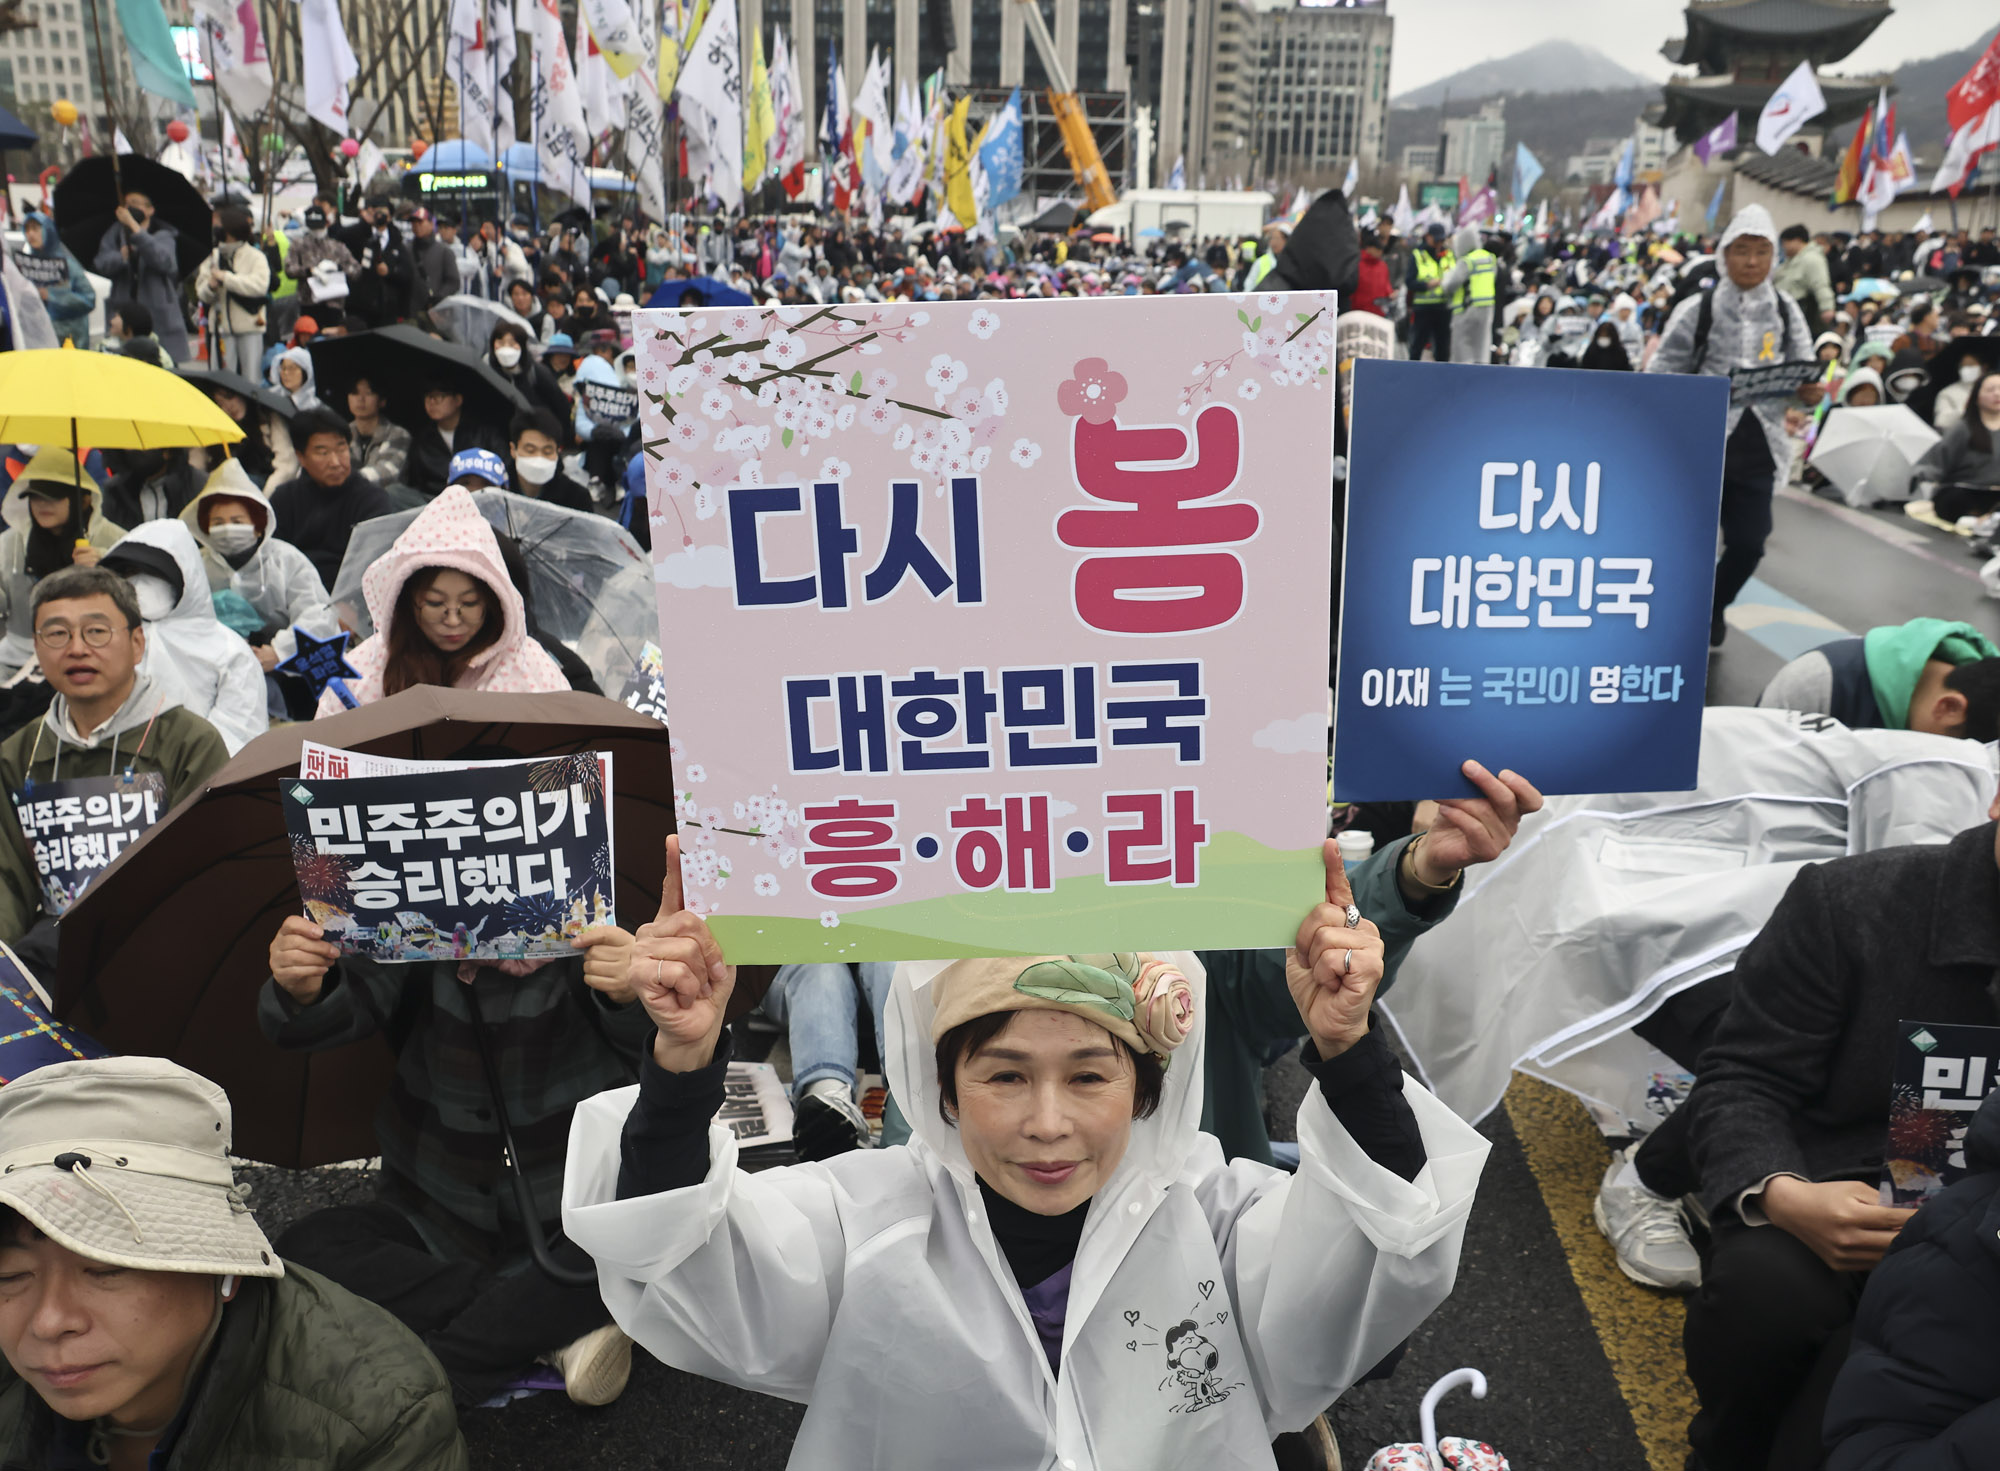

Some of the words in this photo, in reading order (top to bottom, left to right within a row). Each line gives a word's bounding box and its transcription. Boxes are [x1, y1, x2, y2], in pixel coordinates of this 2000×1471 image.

[727, 477, 984, 609] 다시
[1055, 403, 1262, 636] 봄
[1479, 459, 1601, 535] 다시
[1410, 553, 1654, 629] 대한민국
[786, 662, 1206, 773] 대한민국
[1361, 667, 1430, 707] 이재
[1439, 667, 1472, 706] 는
[1482, 666, 1580, 705] 국민이
[1590, 664, 1684, 704] 명한다
[17, 790, 159, 838] 민주주의가
[306, 783, 591, 855] 민주주의가
[347, 848, 571, 910] 승리했다
[1922, 1056, 2000, 1111] 민
